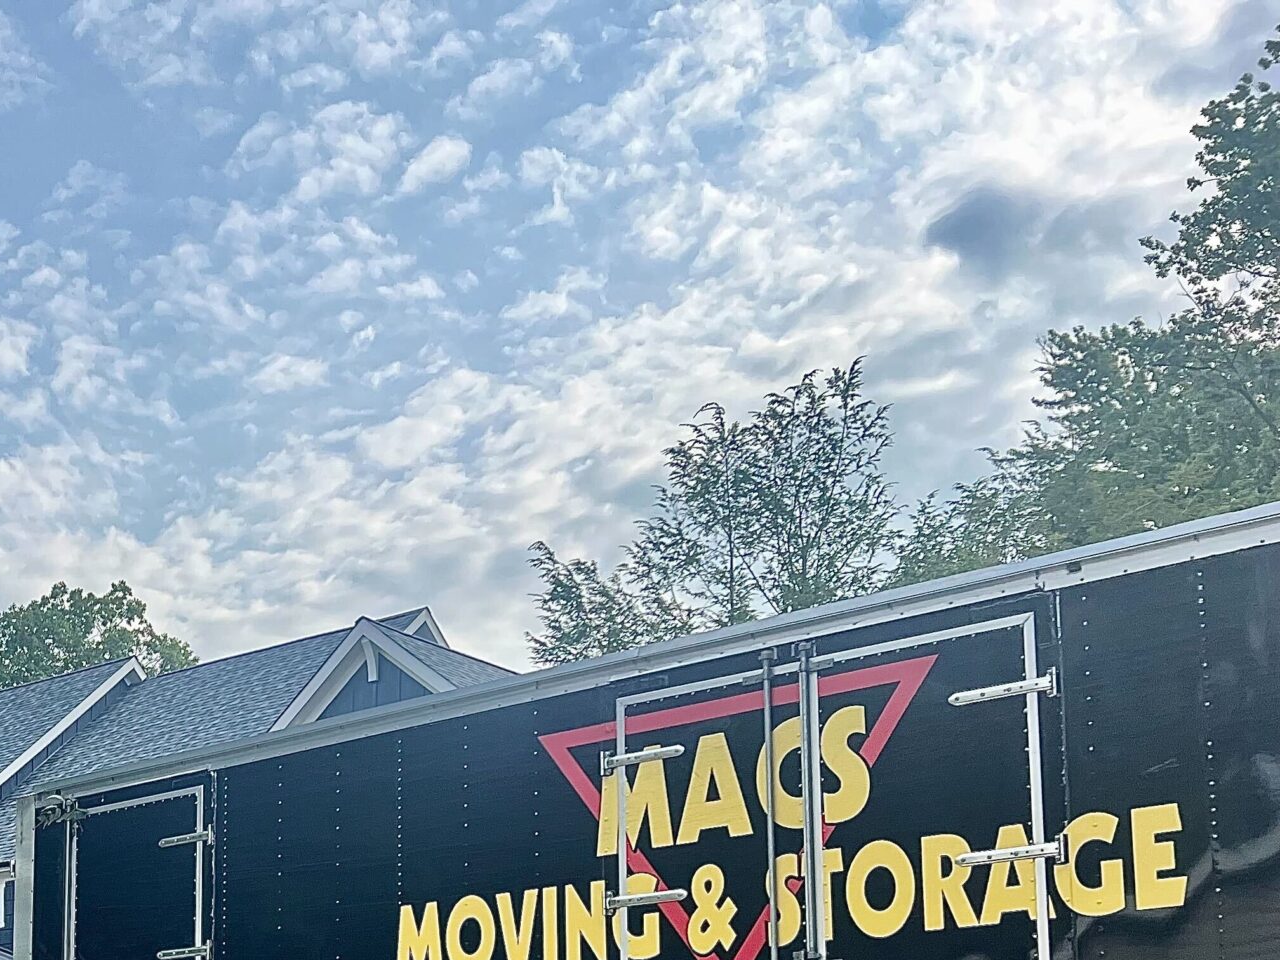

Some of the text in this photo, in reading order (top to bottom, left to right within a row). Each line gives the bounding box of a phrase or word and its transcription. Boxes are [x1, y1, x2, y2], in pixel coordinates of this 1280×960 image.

[596, 704, 871, 858] MACS
[687, 862, 738, 955] &
[765, 802, 1189, 948] STORAGE
